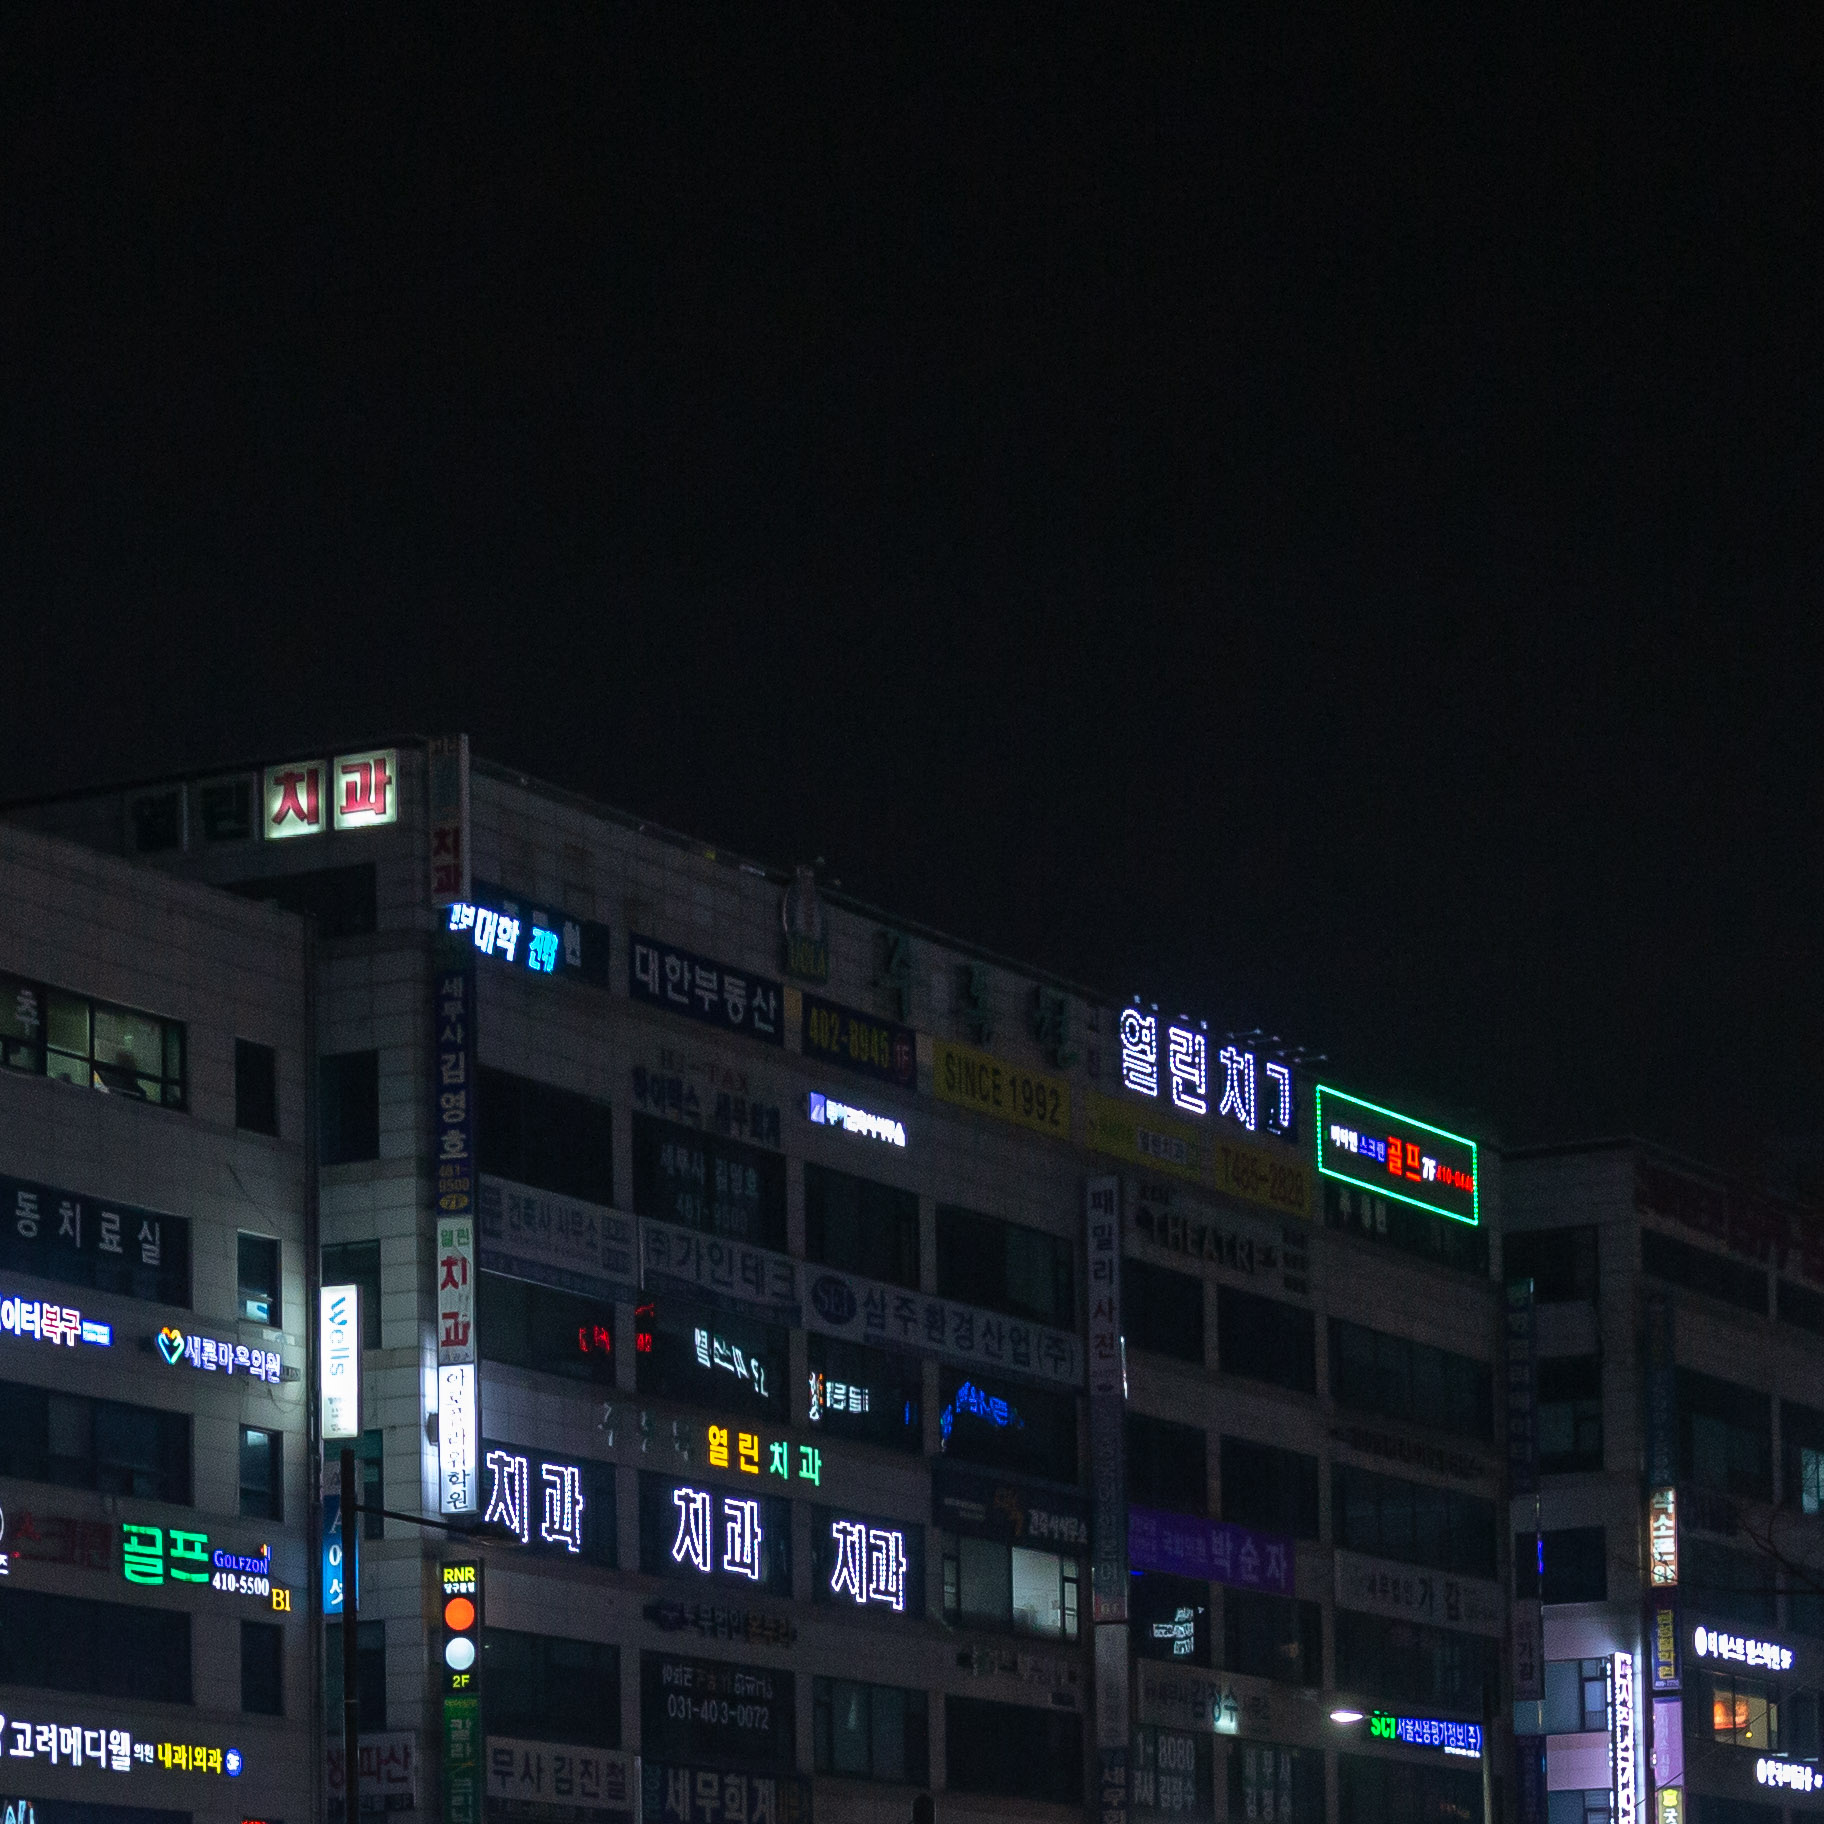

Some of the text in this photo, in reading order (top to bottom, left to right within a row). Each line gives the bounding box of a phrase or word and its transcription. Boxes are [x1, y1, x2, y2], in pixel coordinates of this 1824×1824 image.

[272, 757, 394, 827] 치과
[943, 1054, 1064, 1127] SINCE 1992
[1388, 1136, 1421, 1182] 골프
[484, 1450, 586, 1553] 치과
[123, 1523, 209, 1586] 골프
[671, 1487, 763, 1580] 치과
[212, 1571, 269, 1597] 410-5500
[214, 1550, 268, 1574] GOLFZON
[443, 1567, 475, 1582] RNR
[831, 1520, 908, 1611] 치과
[272, 1588, 290, 1612] B1
[452, 1675, 470, 1688] 2F
[9, 1721, 131, 1772] 고려메디웰
